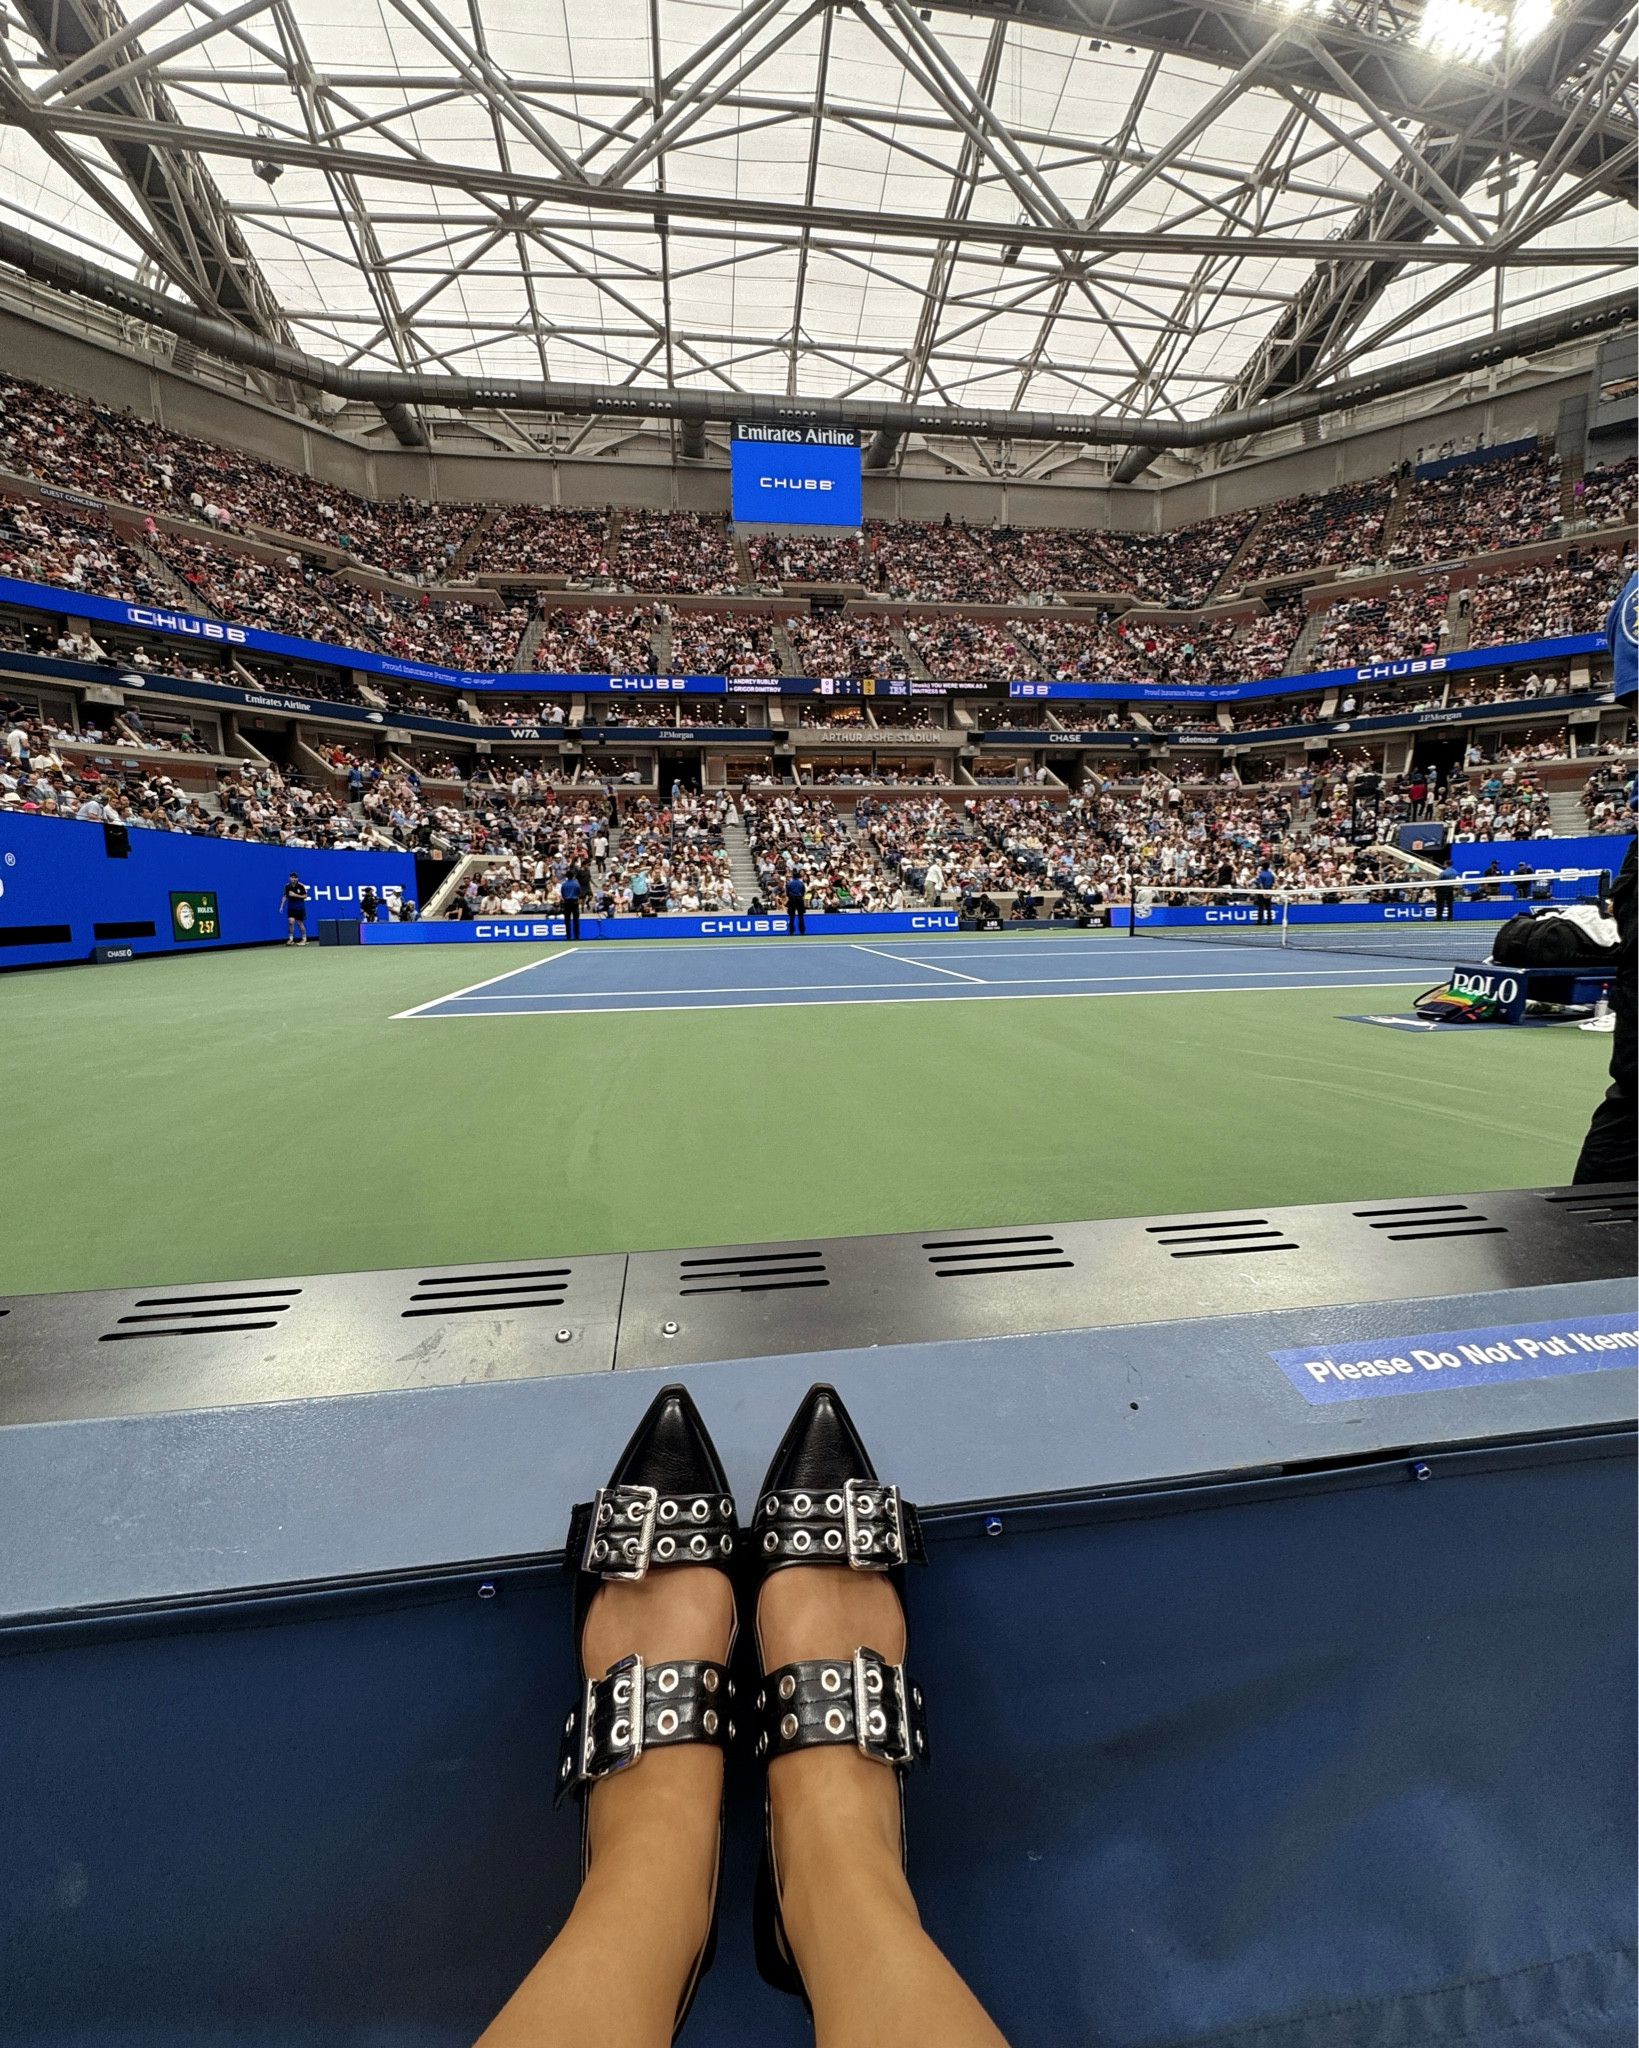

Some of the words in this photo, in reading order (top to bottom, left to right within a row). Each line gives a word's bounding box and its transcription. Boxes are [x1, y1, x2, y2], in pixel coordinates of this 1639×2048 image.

[738, 424, 802, 442] Emirates
[805, 429, 855, 446] Airline
[760, 477, 833, 491] CHUBB
[40, 487, 64, 499] GUEST
[128, 607, 246, 643] CHUBB
[382, 661, 402, 673] Proud
[403, 665, 434, 678] Insurance
[434, 671, 458, 682] Partner
[1357, 658, 1447, 680] CHUBB
[609, 678, 686, 690] CHUBB
[889, 686, 907, 695] IBM
[245, 694, 282, 707] Emirates
[283, 699, 311, 711] Airline
[510, 729, 540, 739] WTA
[822, 732, 863, 742] ARTHUR
[866, 732, 894, 743] ASHE
[896, 732, 941, 743] STADIUM
[1049, 734, 1082, 743] CHASE
[1178, 735, 1219, 744] ticketmaster
[701, 920, 788, 933] CHUBB
[107, 949, 127, 958] CHASE
[1453, 973, 1518, 1003] POLO
[1303, 1357, 1414, 1383] Please
[1410, 1349, 1461, 1371] Do
[1457, 1342, 1523, 1365] Not
[1513, 1337, 1578, 1359] Put
